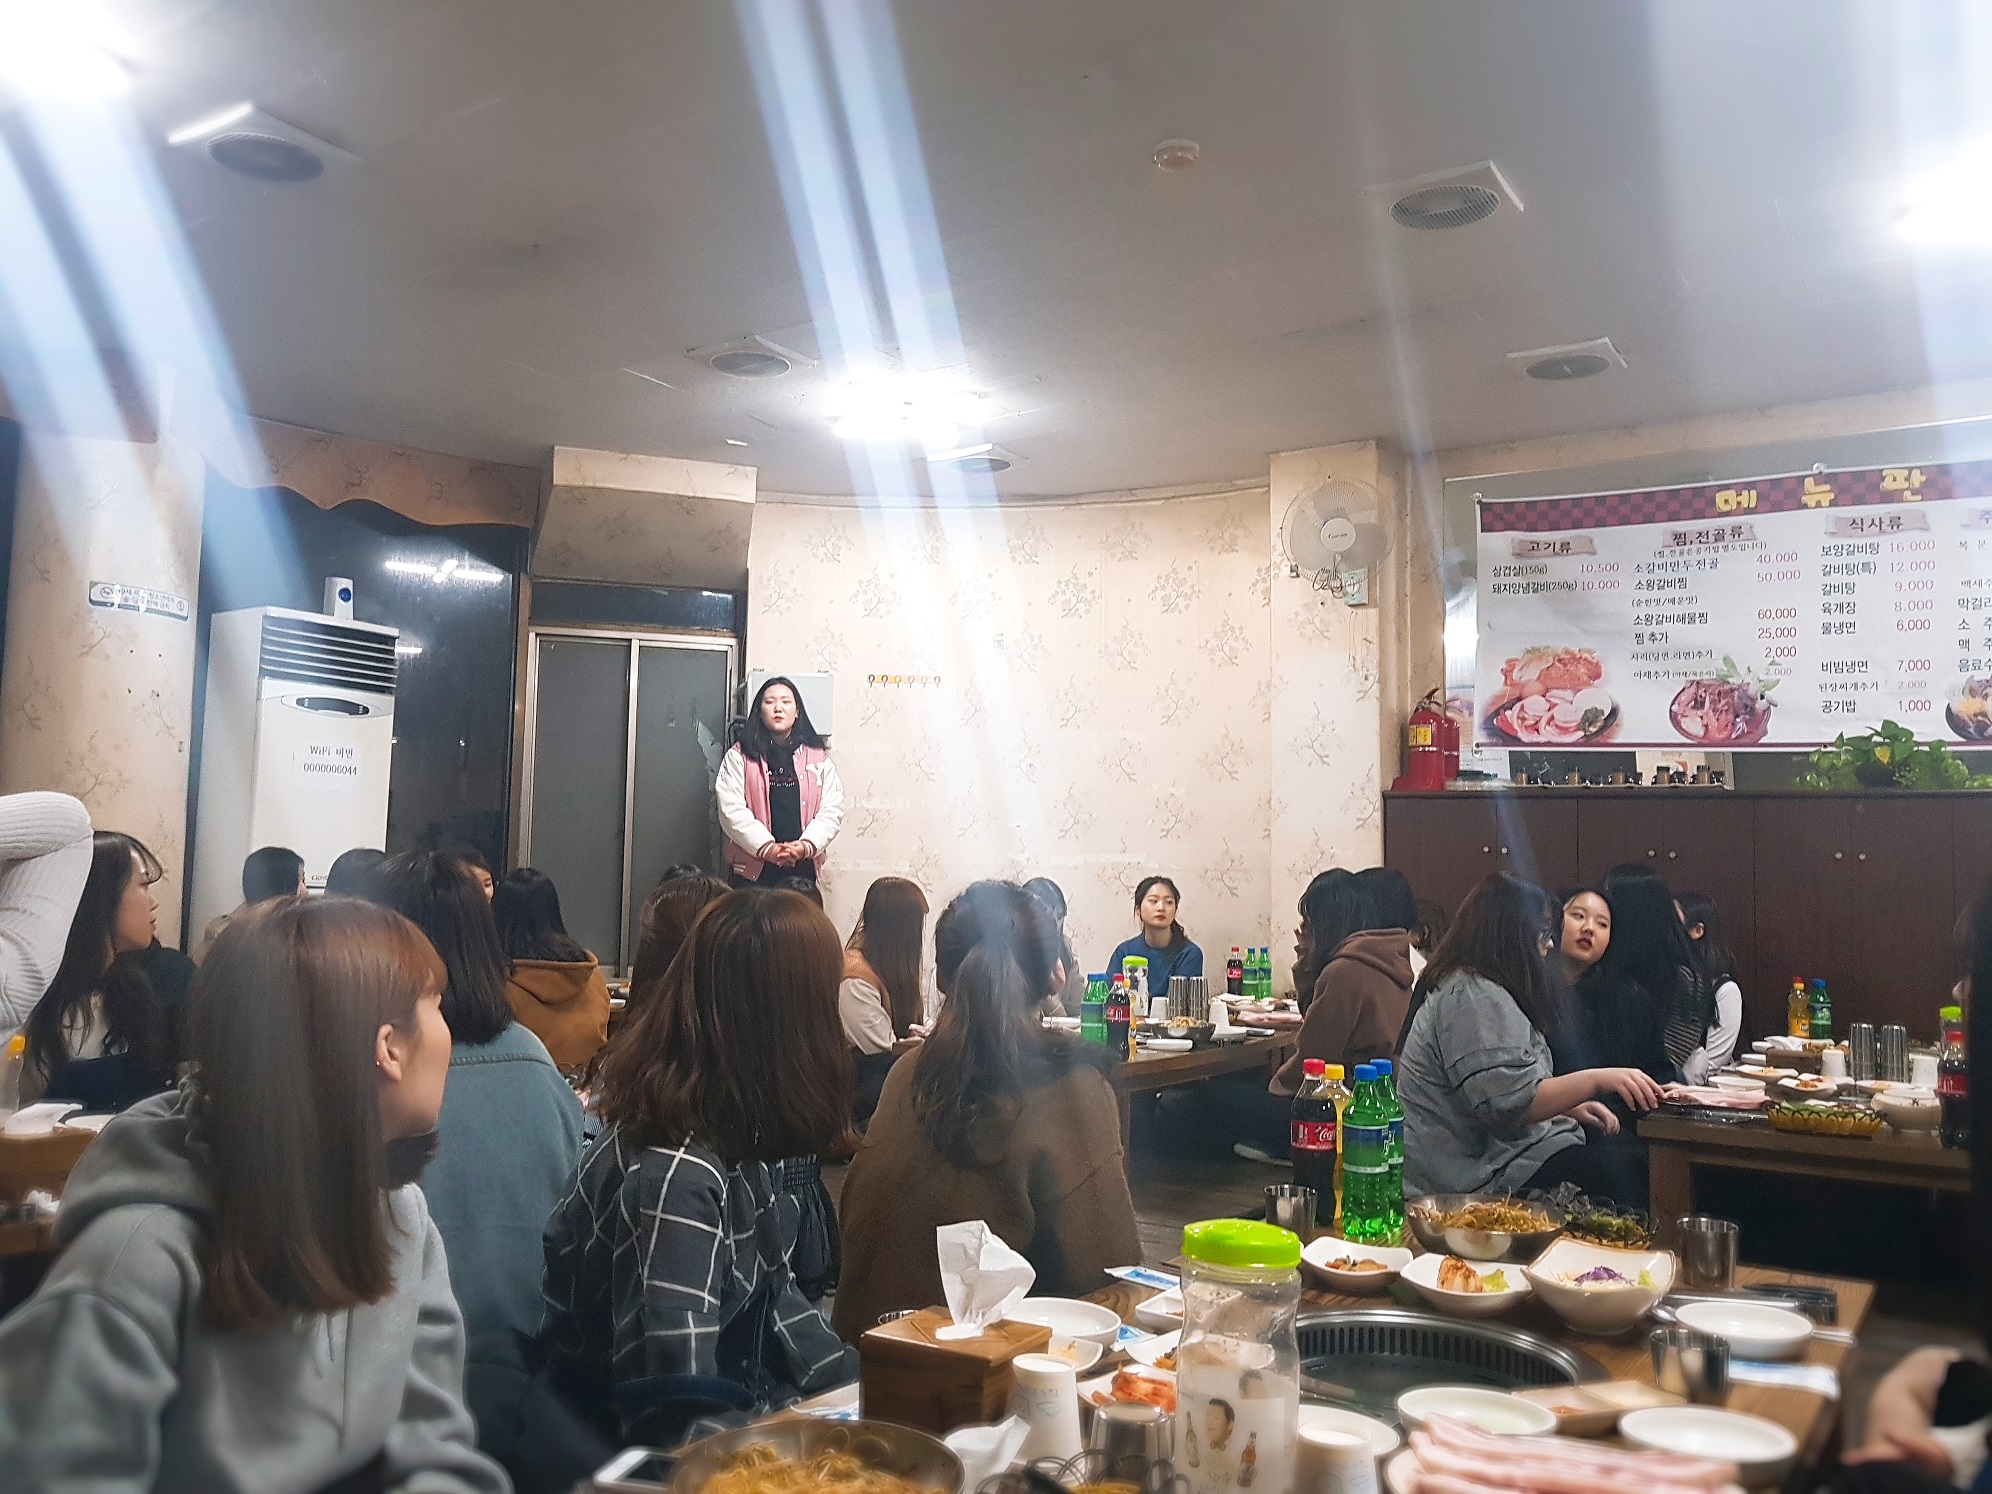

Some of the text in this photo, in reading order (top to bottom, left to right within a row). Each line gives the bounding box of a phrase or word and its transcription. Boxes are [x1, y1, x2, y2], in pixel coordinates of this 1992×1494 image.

[1849, 516, 1904, 532] 식사류
[1673, 525, 1744, 546] 찜,전골류
[1528, 541, 1572, 553] 고기류
[1820, 541, 1880, 557] 보양갈비탕
[1821, 581, 1856, 596] 갈비탕
[1757, 607, 1797, 621] 60,000
[1821, 601, 1856, 615] 육개장
[1757, 626, 1797, 640] 25,000
[1821, 619, 1931, 635] 물냉면 6,000
[1765, 646, 1797, 660] 2,000
[1821, 659, 1931, 674] 비빔냉면 7,000
[1821, 699, 1931, 713] 공기밥 1,000
